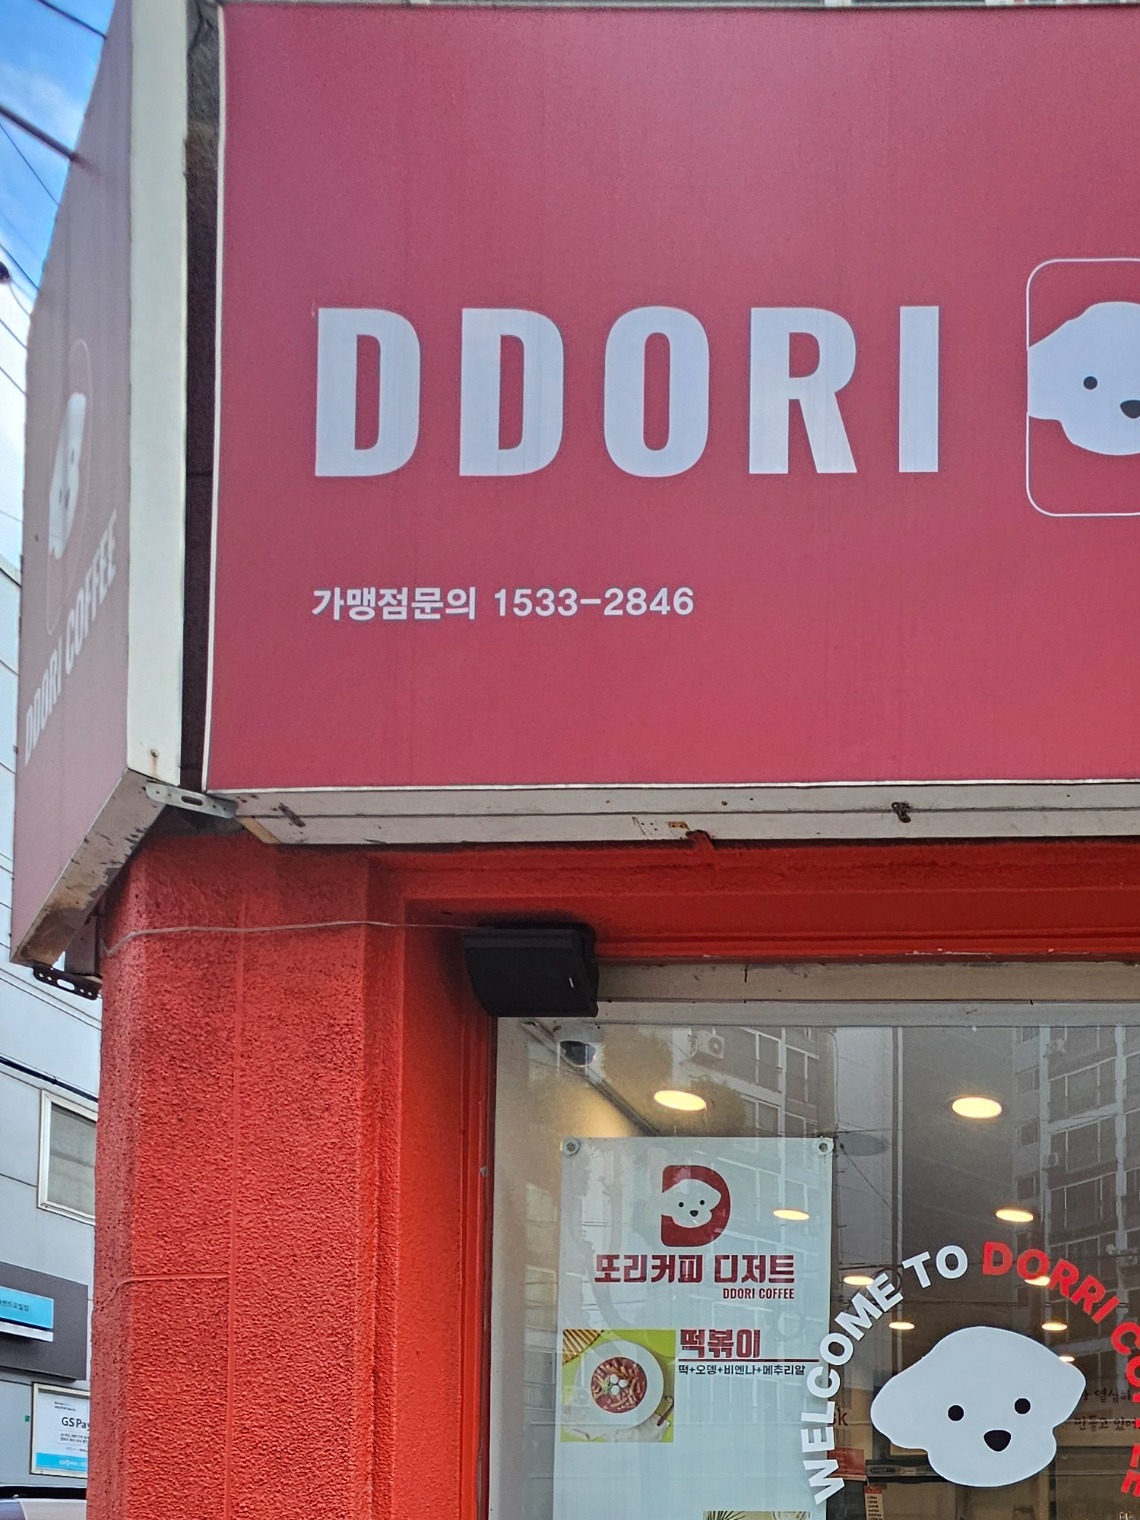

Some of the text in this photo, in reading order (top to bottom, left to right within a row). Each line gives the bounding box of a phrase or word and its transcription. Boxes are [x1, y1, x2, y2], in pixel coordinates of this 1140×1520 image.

[313, 305, 942, 478] DDORI
[311, 586, 695, 622] 가맹점문의 1533-2846
[24, 507, 117, 766] DDORI COFFEE
[594, 1253, 796, 1284] 또리커피 디저트
[722, 1287, 795, 1300] DDORI COFFEE
[679, 1328, 762, 1359] 떡볶이
[800, 1272, 904, 1506] WELCOME
[901, 1244, 969, 1290] TO
[981, 1240, 1120, 1324] DORRI
